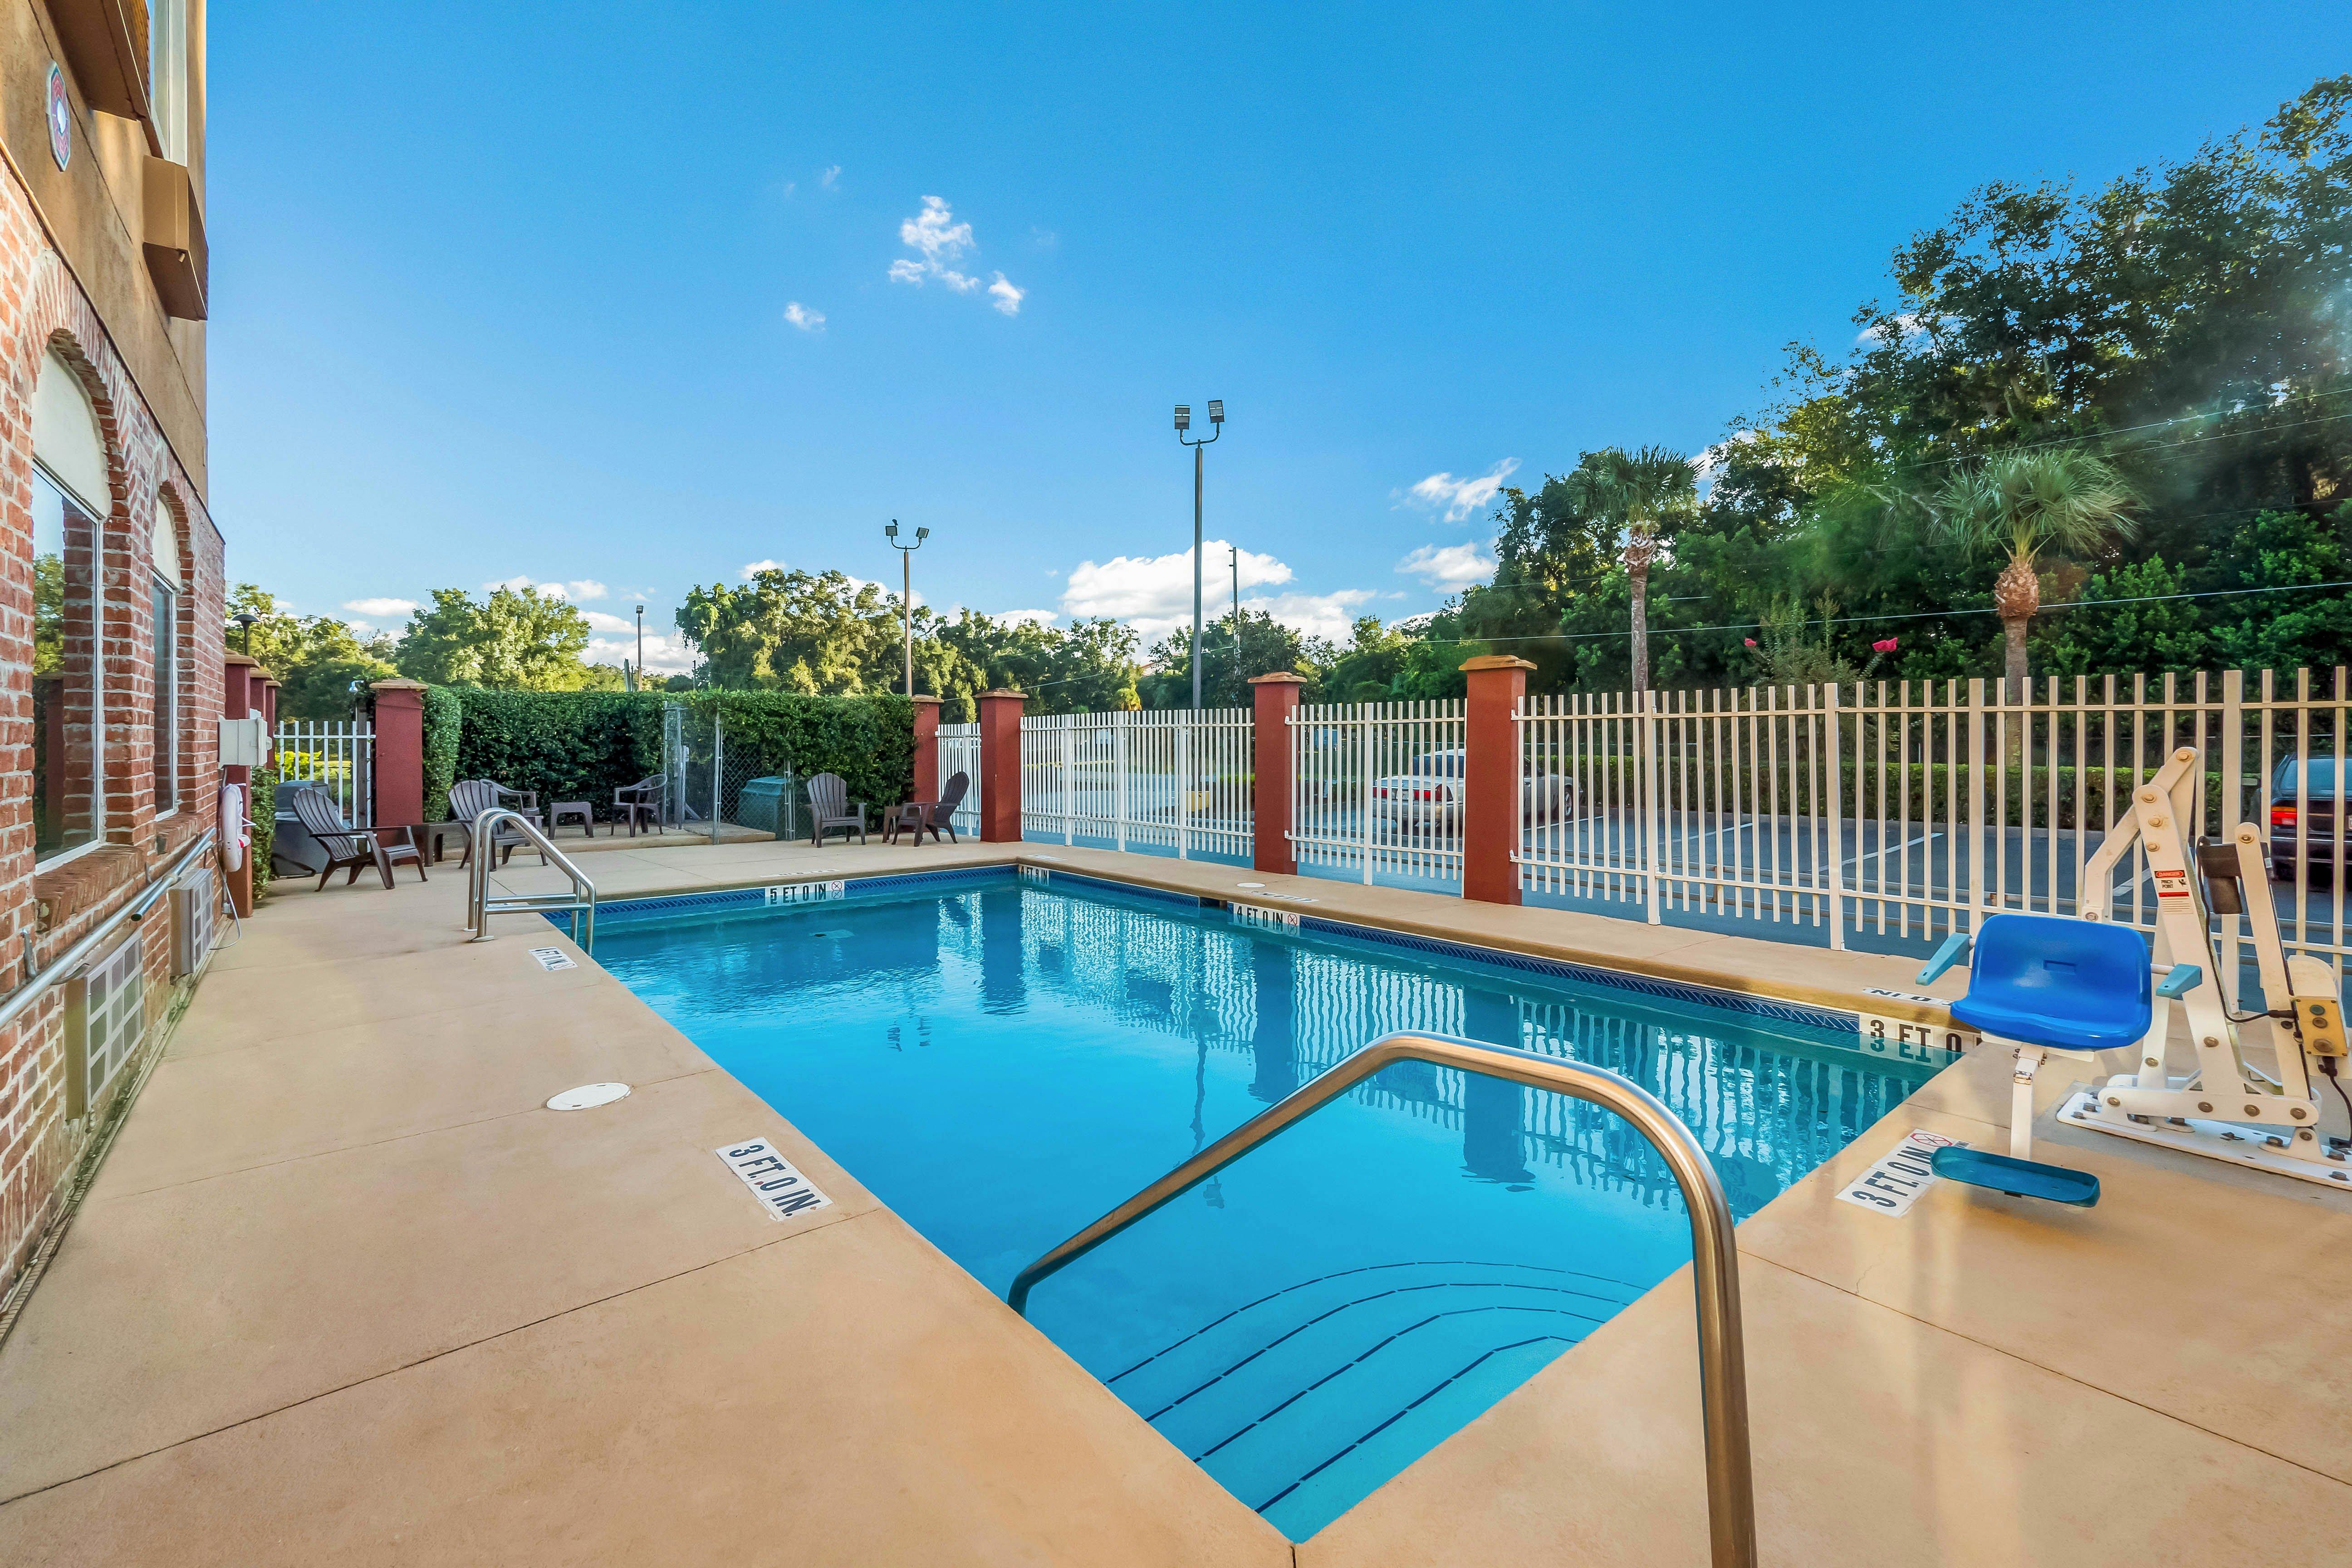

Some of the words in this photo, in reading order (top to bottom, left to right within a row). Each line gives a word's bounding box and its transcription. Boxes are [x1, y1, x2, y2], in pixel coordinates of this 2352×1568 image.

[770, 888, 777, 897] 5
[783, 886, 797, 896] FT
[814, 883, 826, 893] IN
[1237, 906, 1243, 916] 4
[1247, 907, 1258, 918] FT
[1273, 911, 1283, 924] IN
[1870, 1019, 1885, 1038] 3
[1899, 1024, 1931, 1047] FT
[729, 1145, 764, 1157] 3
[738, 1156, 787, 1179] FT.
[1864, 1170, 1920, 1197] FT.
[771, 1188, 822, 1217] IN.
[1852, 1191, 1897, 1207] 3
